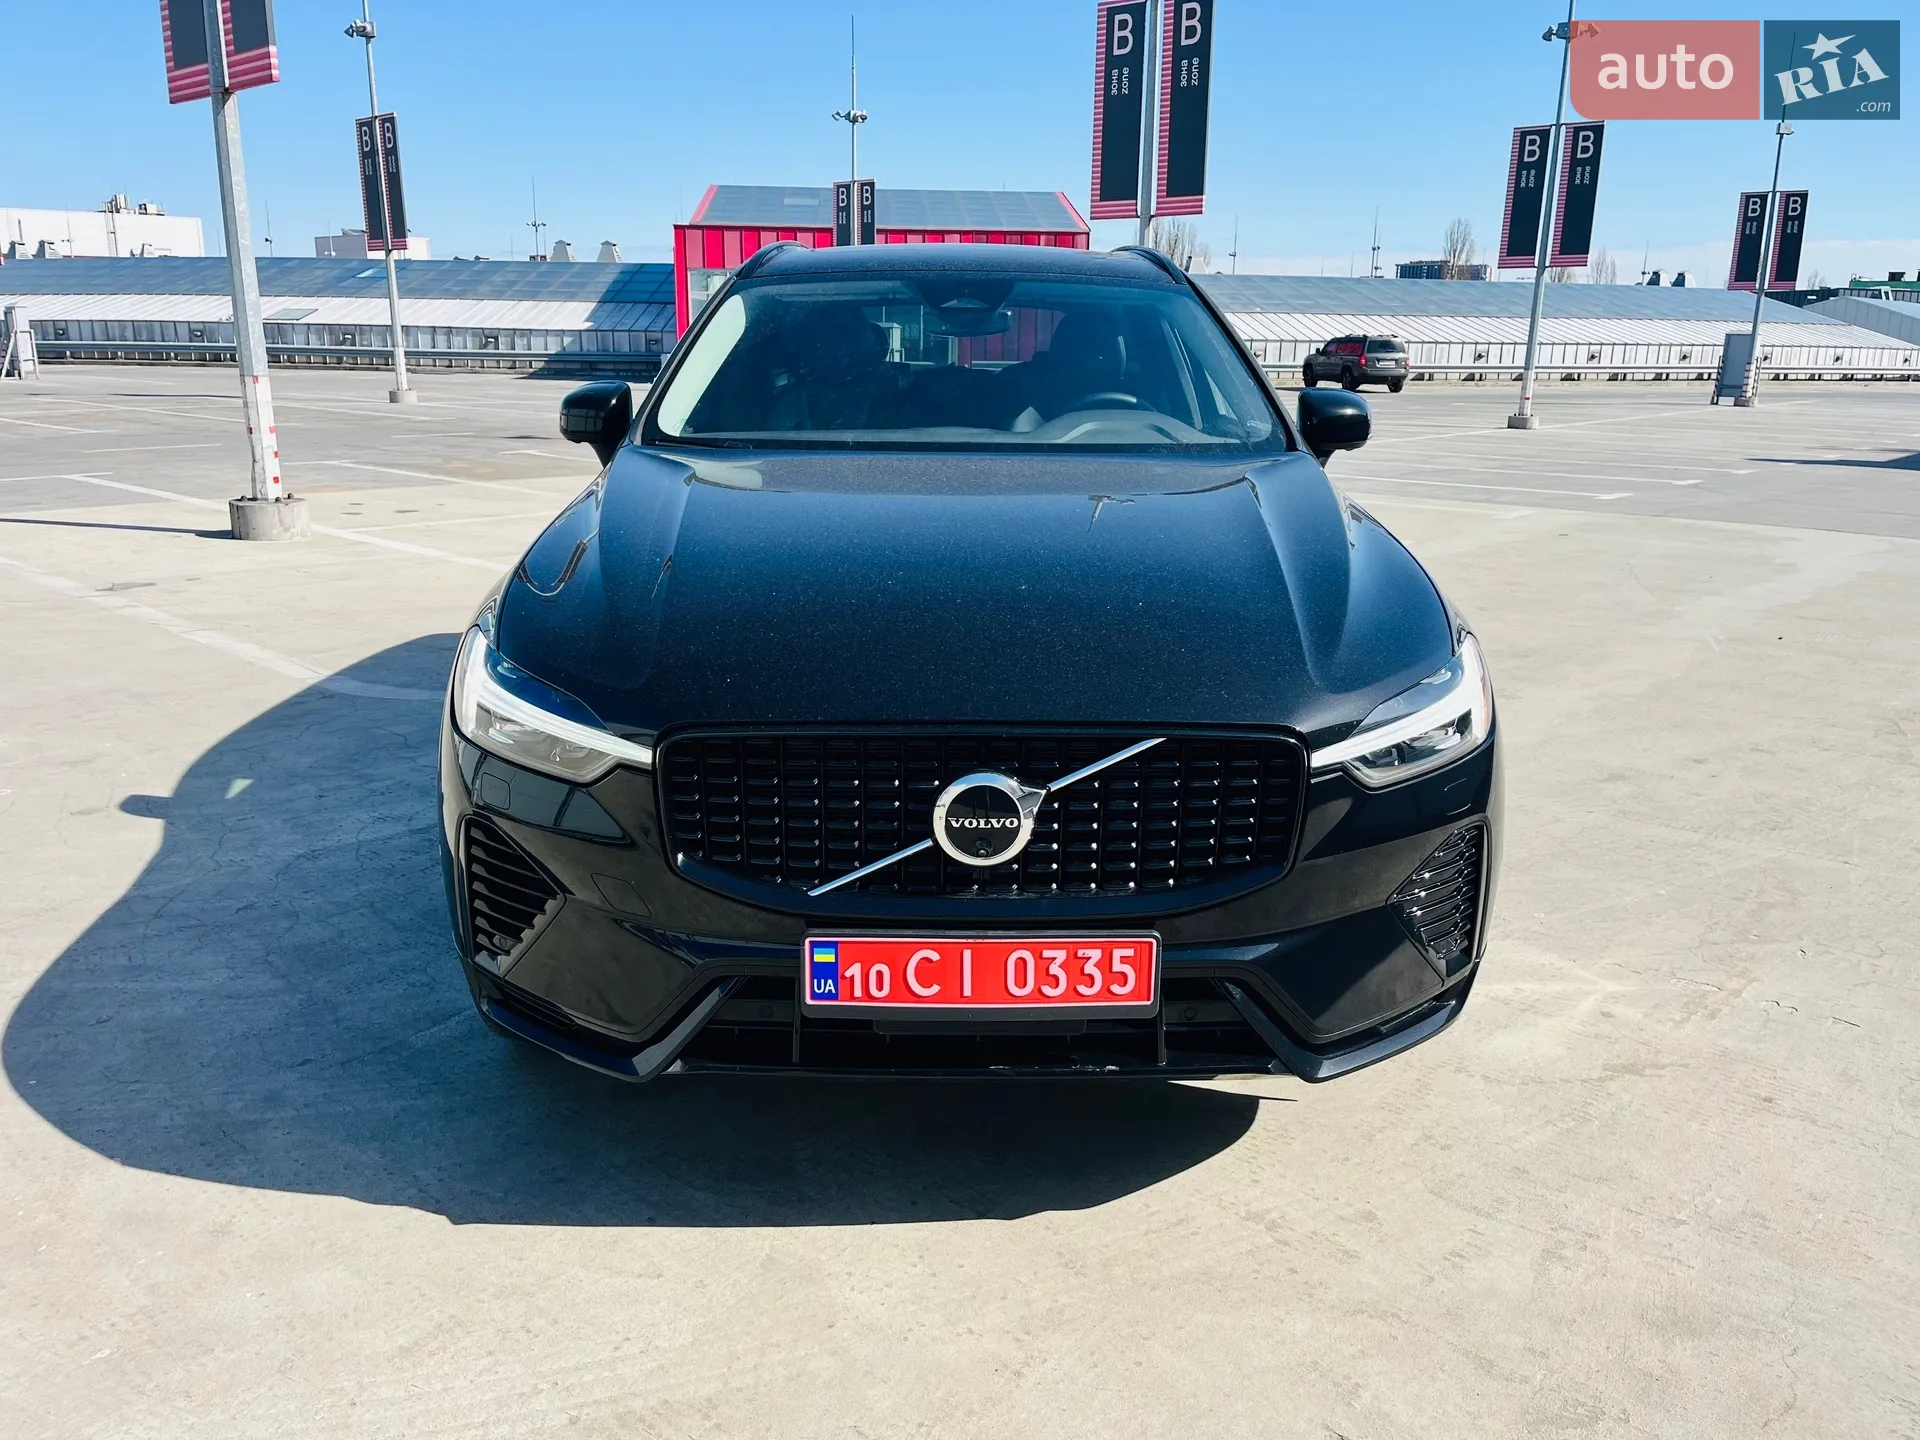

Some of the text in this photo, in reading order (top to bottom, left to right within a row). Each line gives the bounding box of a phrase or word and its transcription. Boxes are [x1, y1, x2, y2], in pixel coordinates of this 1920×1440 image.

[1112, 13, 1134, 56] B
[1180, 1, 1202, 46] B
[1111, 68, 1119, 96] зона
[1121, 66, 1130, 95] zone
[1180, 59, 1188, 88] зона
[1191, 57, 1199, 86] zone
[361, 126, 371, 152] B
[384, 122, 394, 149] B
[1523, 134, 1541, 162] B
[1576, 130, 1595, 159] B
[838, 187, 848, 207] B
[863, 185, 872, 205] B
[1747, 197, 1761, 217] B
[1787, 196, 1802, 216] B
[947, 817, 1019, 829] VOLVO
[813, 978, 836, 994] UA
[843, 962, 891, 999] 10
[1004, 947, 1137, 997] 0335
